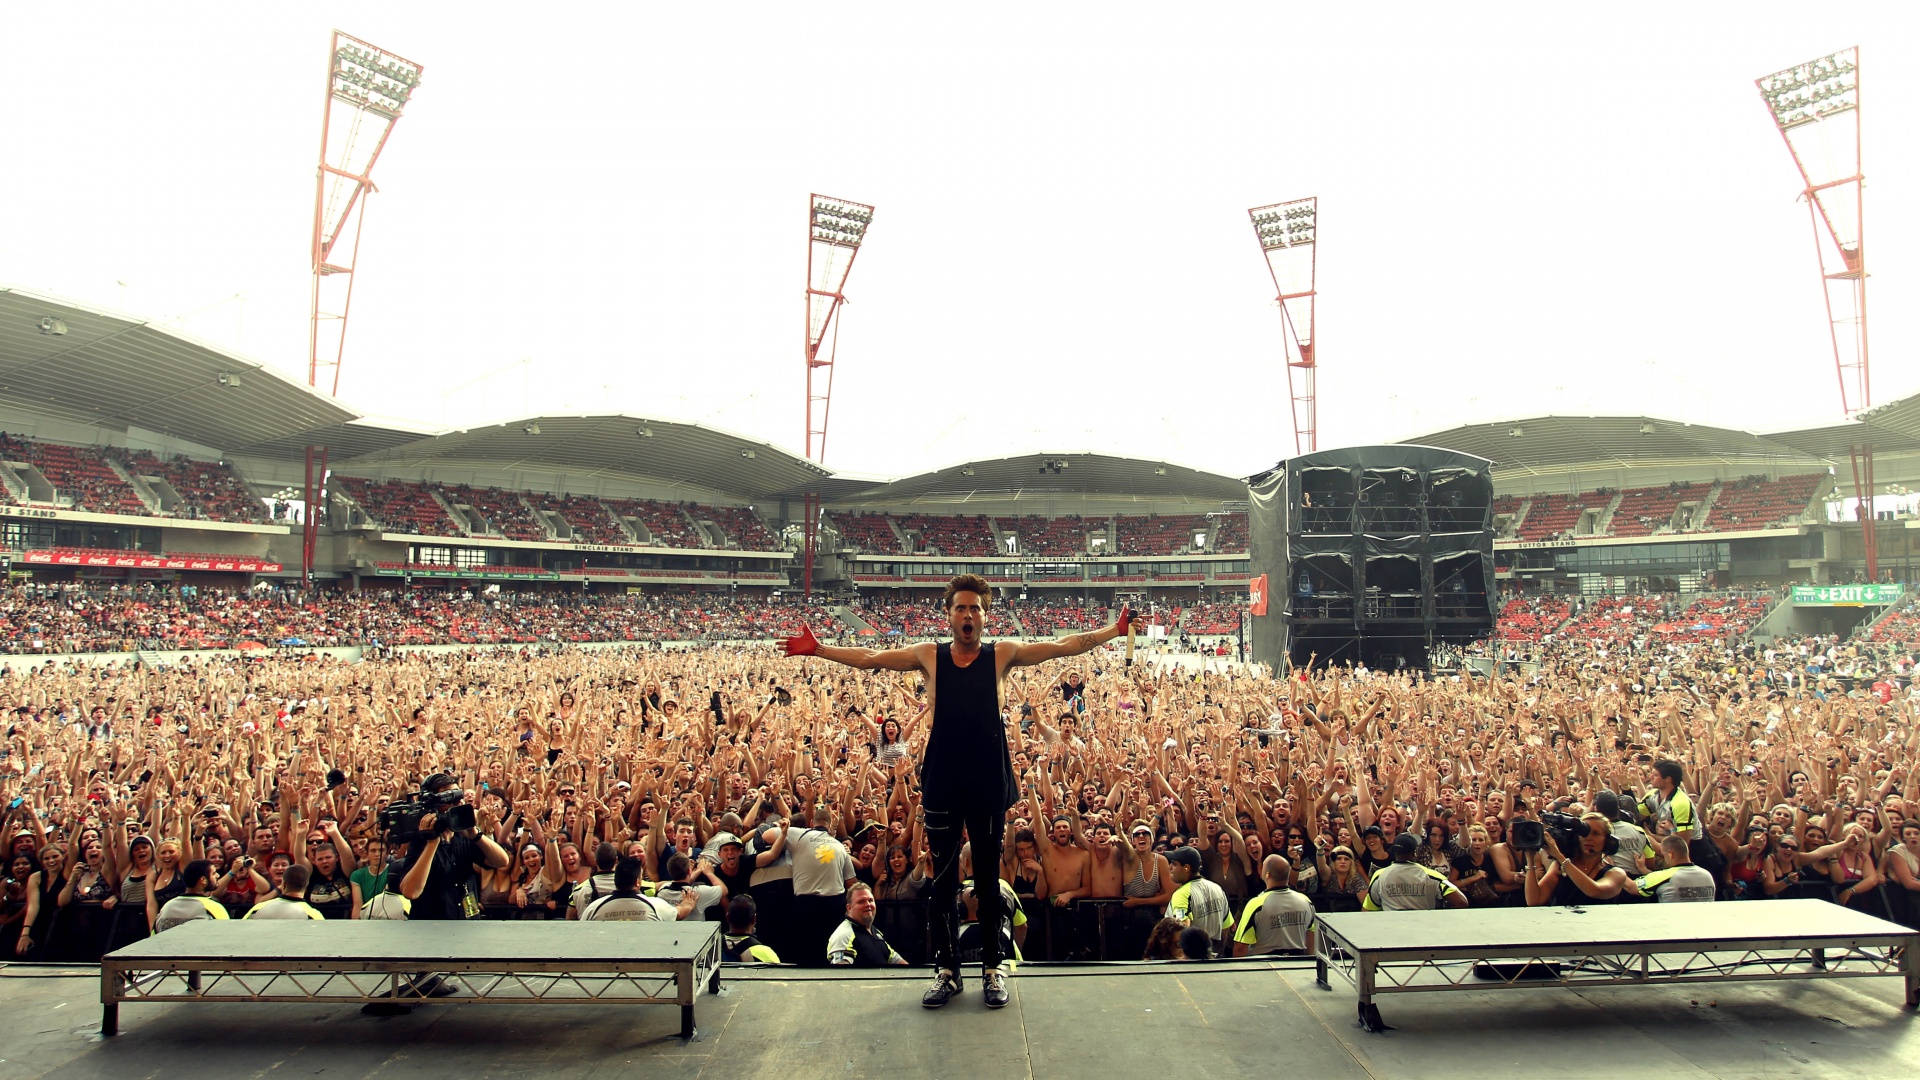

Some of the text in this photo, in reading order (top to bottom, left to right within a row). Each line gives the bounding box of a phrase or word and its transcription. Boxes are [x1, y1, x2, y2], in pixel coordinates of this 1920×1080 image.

[19, 509, 57, 518] STAND
[1829, 587, 1864, 602] EXIT
[1386, 883, 1426, 896] SECURITY
[1270, 910, 1307, 927] SECURITY
